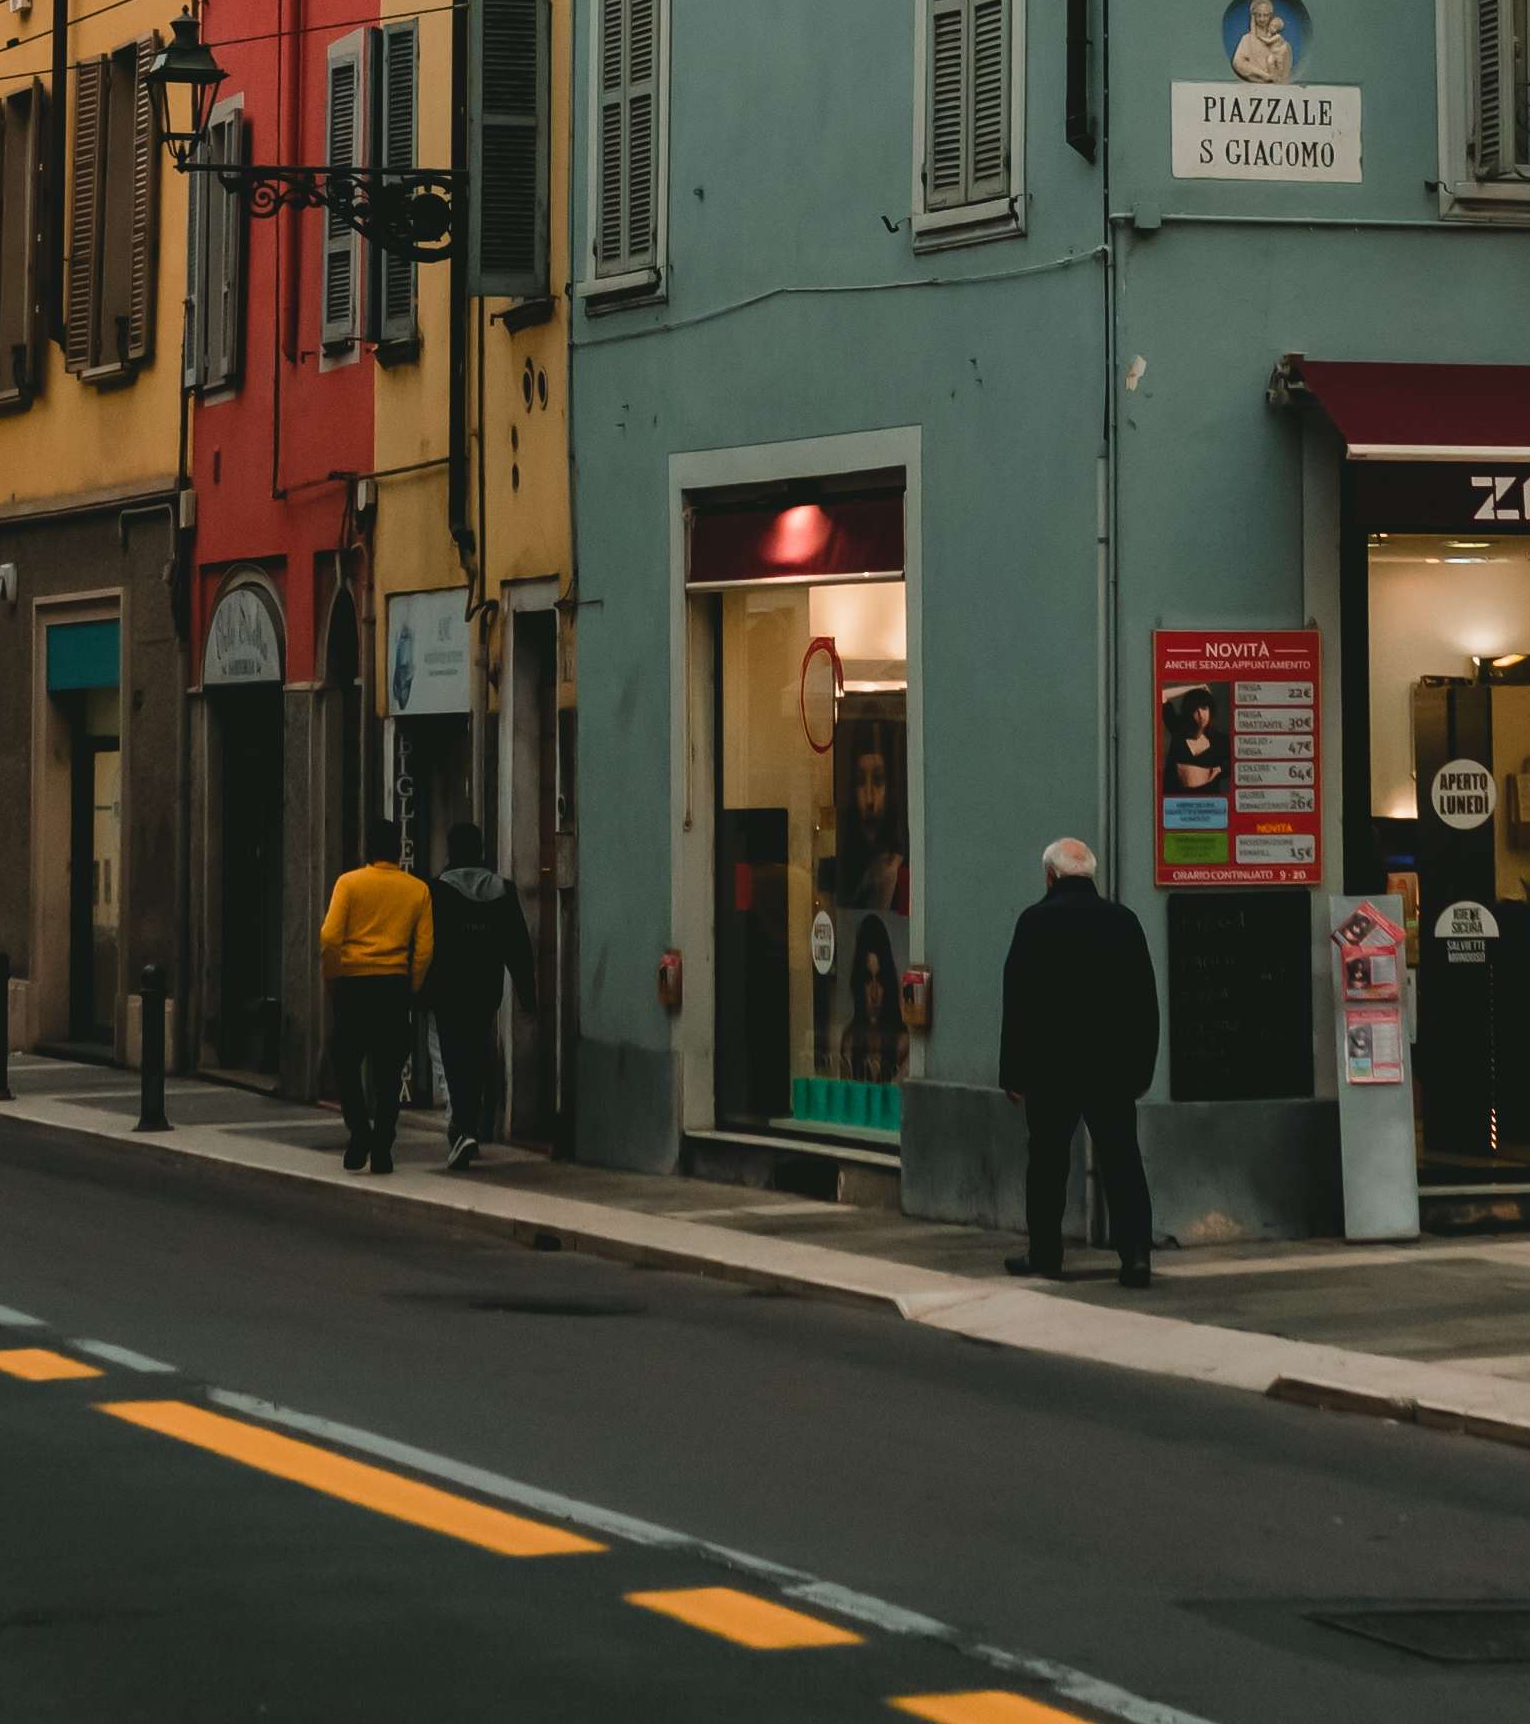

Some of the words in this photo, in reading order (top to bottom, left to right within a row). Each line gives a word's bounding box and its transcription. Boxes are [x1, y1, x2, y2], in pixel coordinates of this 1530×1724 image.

[1202, 96, 1333, 126] PIAZZALE
[1199, 138, 1214, 164] S
[1225, 139, 1335, 168] GIACOMO
[1205, 640, 1270, 658] NOVITÀ
[1164, 660, 1198, 670] ANCHE
[1199, 661, 1231, 670] SENZA
[1232, 661, 1311, 670] APPUNTAMENTO
[1439, 772, 1488, 790] APERTO
[1172, 870, 1210, 881] ORARIO
[1211, 870, 1274, 881] CONTINUATO
[1279, 869, 1287, 881] 9
[1292, 870, 1307, 880] 20
